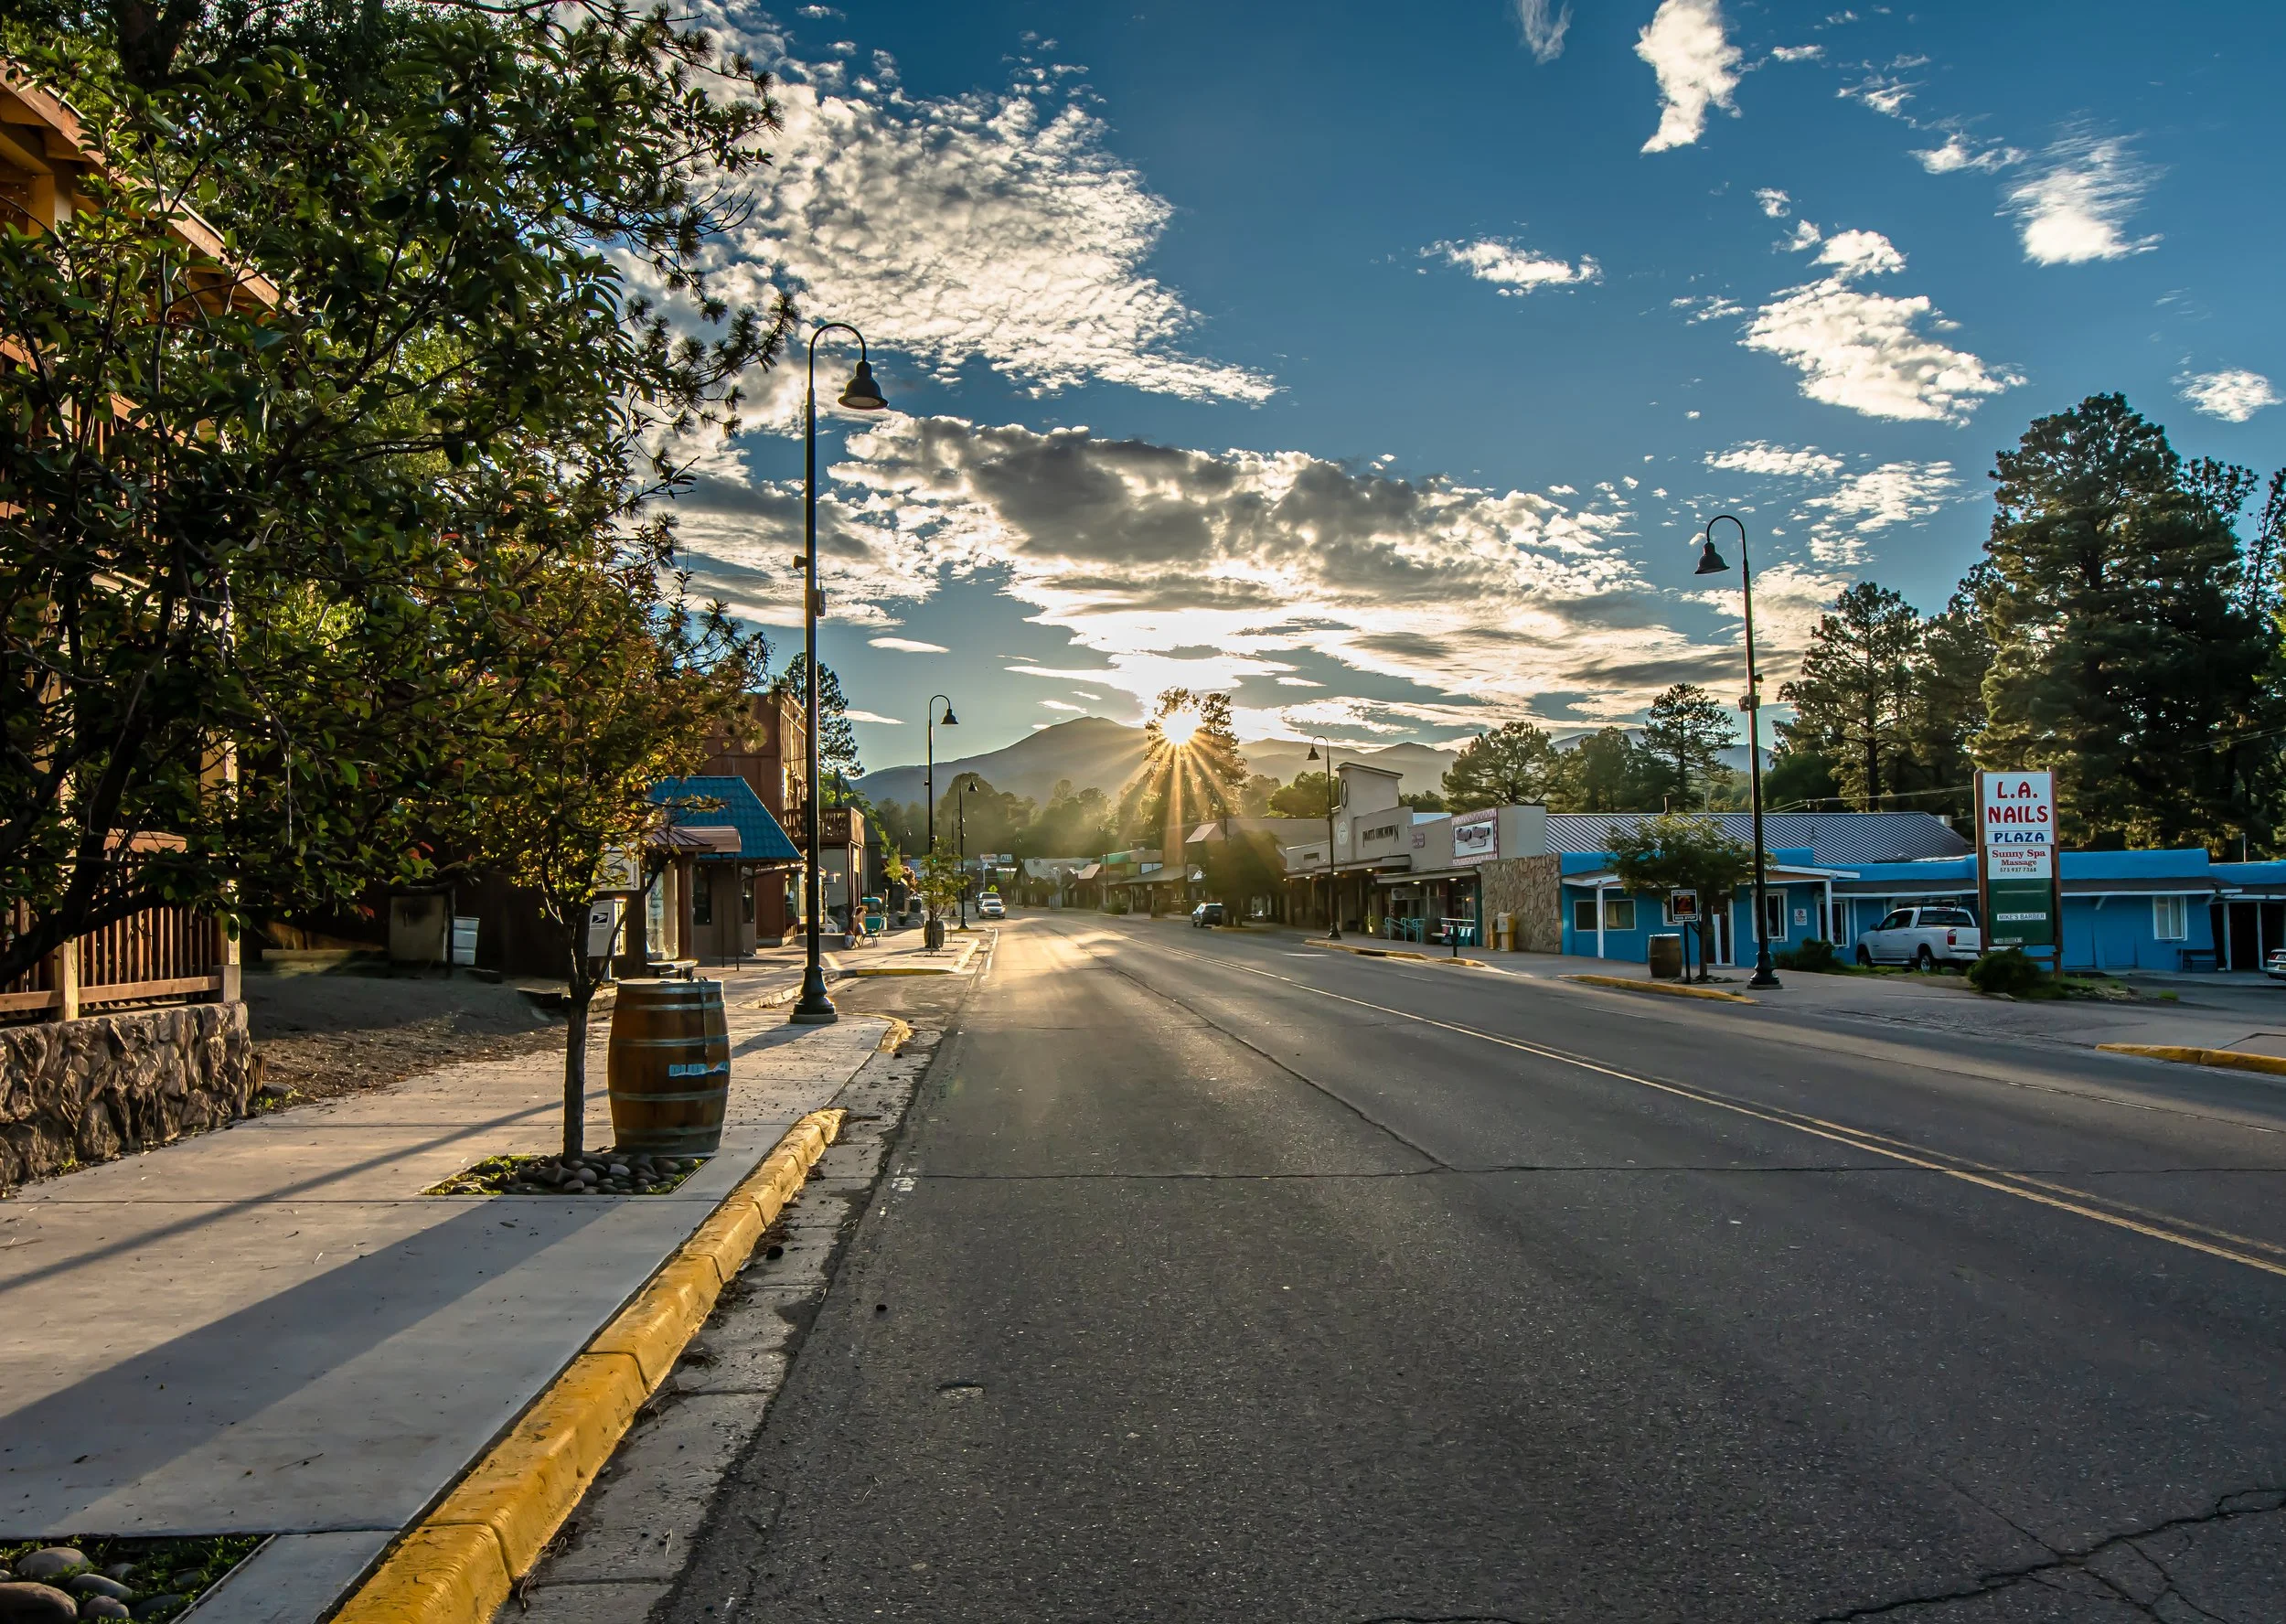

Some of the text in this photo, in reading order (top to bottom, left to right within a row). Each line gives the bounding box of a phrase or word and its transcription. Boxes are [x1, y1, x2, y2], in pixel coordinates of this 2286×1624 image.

[1997, 781, 2038, 799] L.A.
[1988, 805, 2049, 824] NAILS
[1993, 832, 2045, 843] PLAZA
[1992, 849, 2046, 860] Sunny Spa
[2001, 860, 2037, 868] Massage
